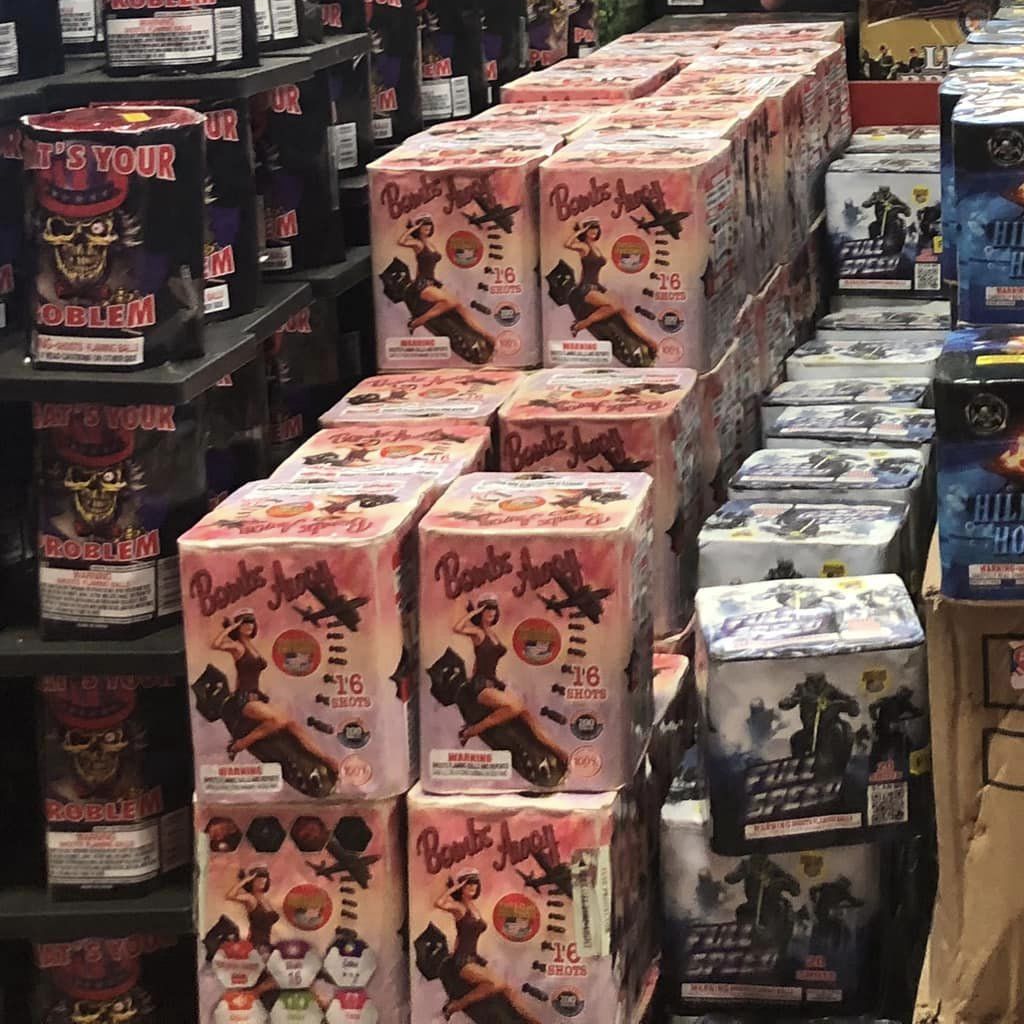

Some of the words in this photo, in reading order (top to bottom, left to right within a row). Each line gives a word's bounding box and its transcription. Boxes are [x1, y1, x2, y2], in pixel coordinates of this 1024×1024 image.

[91, 144, 176, 181] YOUR
[490, 284, 522, 295] SHOTS
[655, 291, 688, 302] SHOTS
[565, 687, 608, 700] SHOTS
[331, 696, 372, 709] SHOTS
[547, 965, 587, 976] SHOTS
